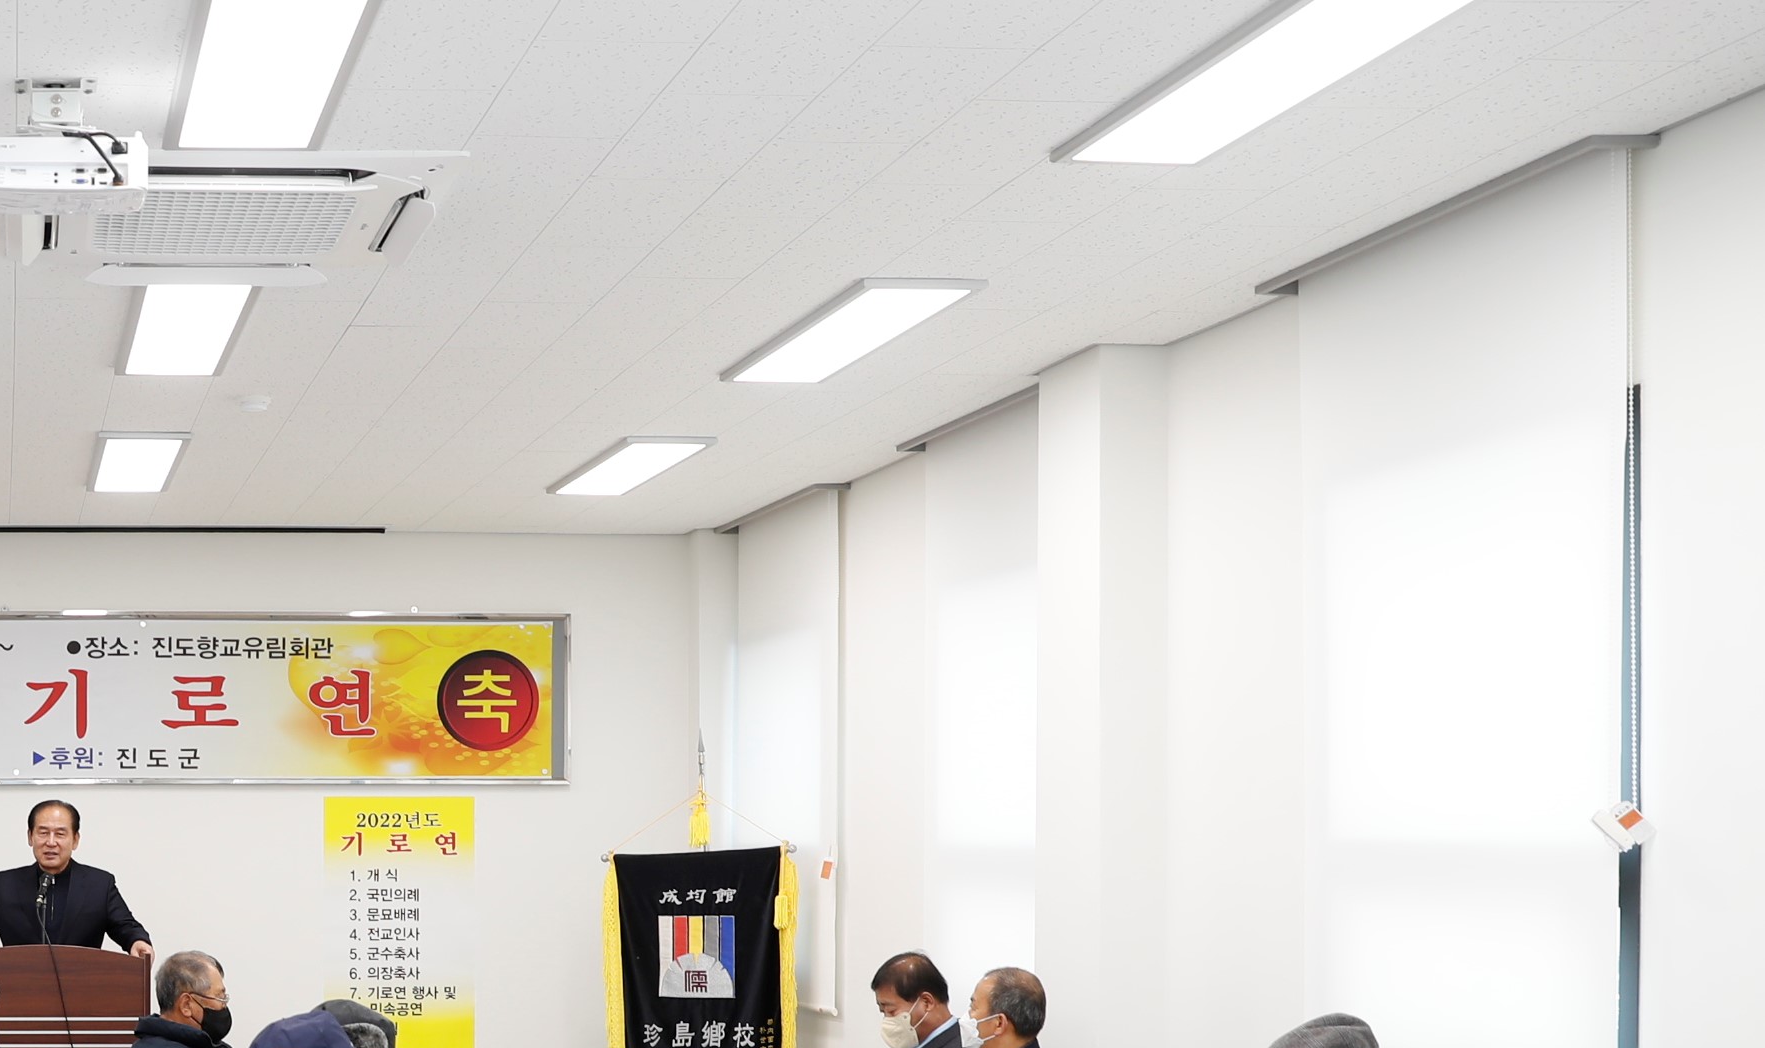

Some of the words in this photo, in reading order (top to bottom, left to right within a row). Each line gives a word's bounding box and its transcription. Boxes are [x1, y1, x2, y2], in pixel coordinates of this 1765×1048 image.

[85, 636, 139, 659] 장소:
[152, 636, 334, 660] 진도향교유림회관
[455, 669, 518, 734] 축
[48, 748, 103, 770] 후원:
[356, 811, 442, 829] 2022년도
[350, 870, 361, 882] 1.
[349, 889, 361, 902] 2.
[367, 888, 420, 902] 국민의례
[349, 908, 361, 922] 3.
[367, 907, 420, 922] 문묘배례
[349, 928, 361, 942] 4.
[367, 927, 420, 942] 전교인사
[349, 947, 361, 961] 5.
[367, 946, 420, 961] 군수축사
[349, 967, 361, 981] 6.
[367, 966, 420, 981] 의장축사
[350, 987, 361, 999] 7.
[367, 986, 406, 1000] 기로연
[412, 986, 439, 1000] 행사
[443, 986, 456, 1000] 및
